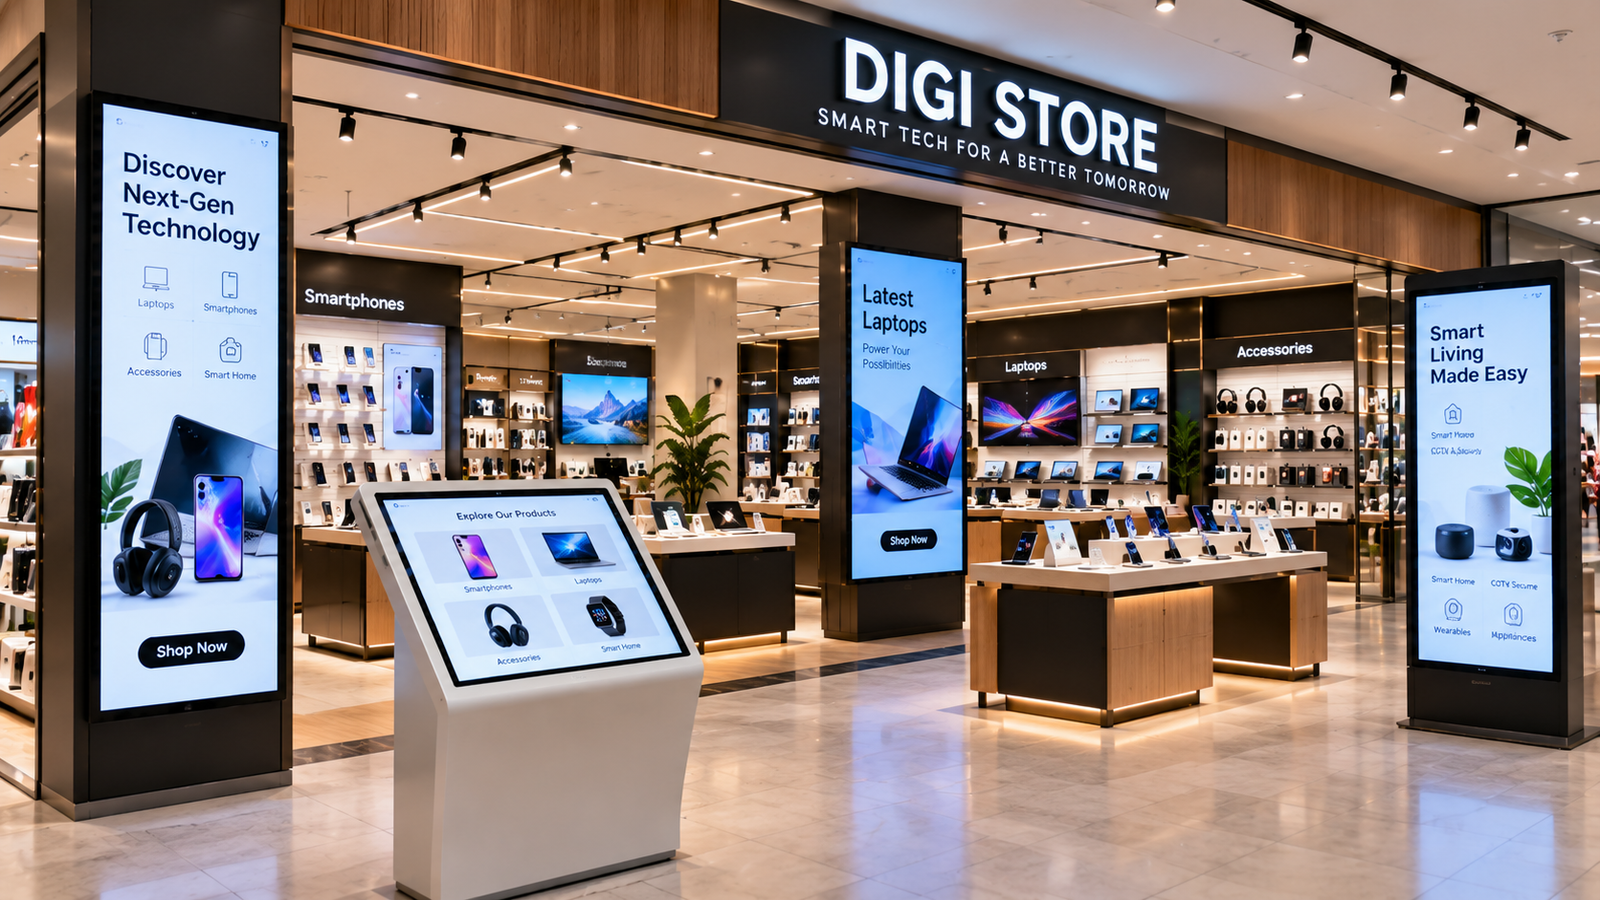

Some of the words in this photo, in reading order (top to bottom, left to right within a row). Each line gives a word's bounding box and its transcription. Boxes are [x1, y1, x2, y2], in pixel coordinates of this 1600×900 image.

[843, 36, 973, 128] DIGI
[994, 80, 1159, 173] STORE
[817, 107, 890, 138] SMART
[898, 125, 948, 152] TECH
[956, 139, 991, 161] FOR
[999, 149, 1010, 165] A
[1017, 153, 1077, 180] BETTER
[1084, 168, 1171, 201] TOMORROW
[123, 151, 226, 185] Discover
[123, 182, 235, 215] Next-Gen
[122, 212, 261, 251] Technology
[304, 288, 405, 312] Smartphones
[863, 283, 914, 307] Latest
[137, 298, 175, 310] Laptops
[203, 302, 258, 316] Smartphones
[863, 310, 927, 337] Laptops
[1430, 323, 1485, 341] Smart
[862, 343, 890, 354] Power
[892, 345, 911, 356] Your
[1236, 342, 1314, 359] Accessories
[1430, 345, 1484, 364] Living
[127, 366, 182, 378] Accessories
[204, 369, 231, 380] Smart
[231, 370, 257, 381] Home
[1004, 360, 1048, 375] Laptops
[1430, 367, 1479, 384] Made
[1485, 366, 1529, 384] Easy
[456, 511, 494, 521] Explore
[495, 510, 513, 519] Our
[515, 509, 557, 518] Products
[890, 535, 910, 547] Shop
[911, 534, 928, 545] Now
[574, 576, 603, 585] Laptops
[1431, 575, 1453, 584] Smart
[1454, 577, 1476, 586] Home
[463, 583, 513, 594] Smartphones
[1433, 626, 1472, 637] Wearables
[156, 644, 193, 659] Shop
[197, 641, 228, 655] Now
[601, 643, 622, 653] Smart
[622, 641, 641, 651] Home
[497, 654, 542, 666] Accessories
